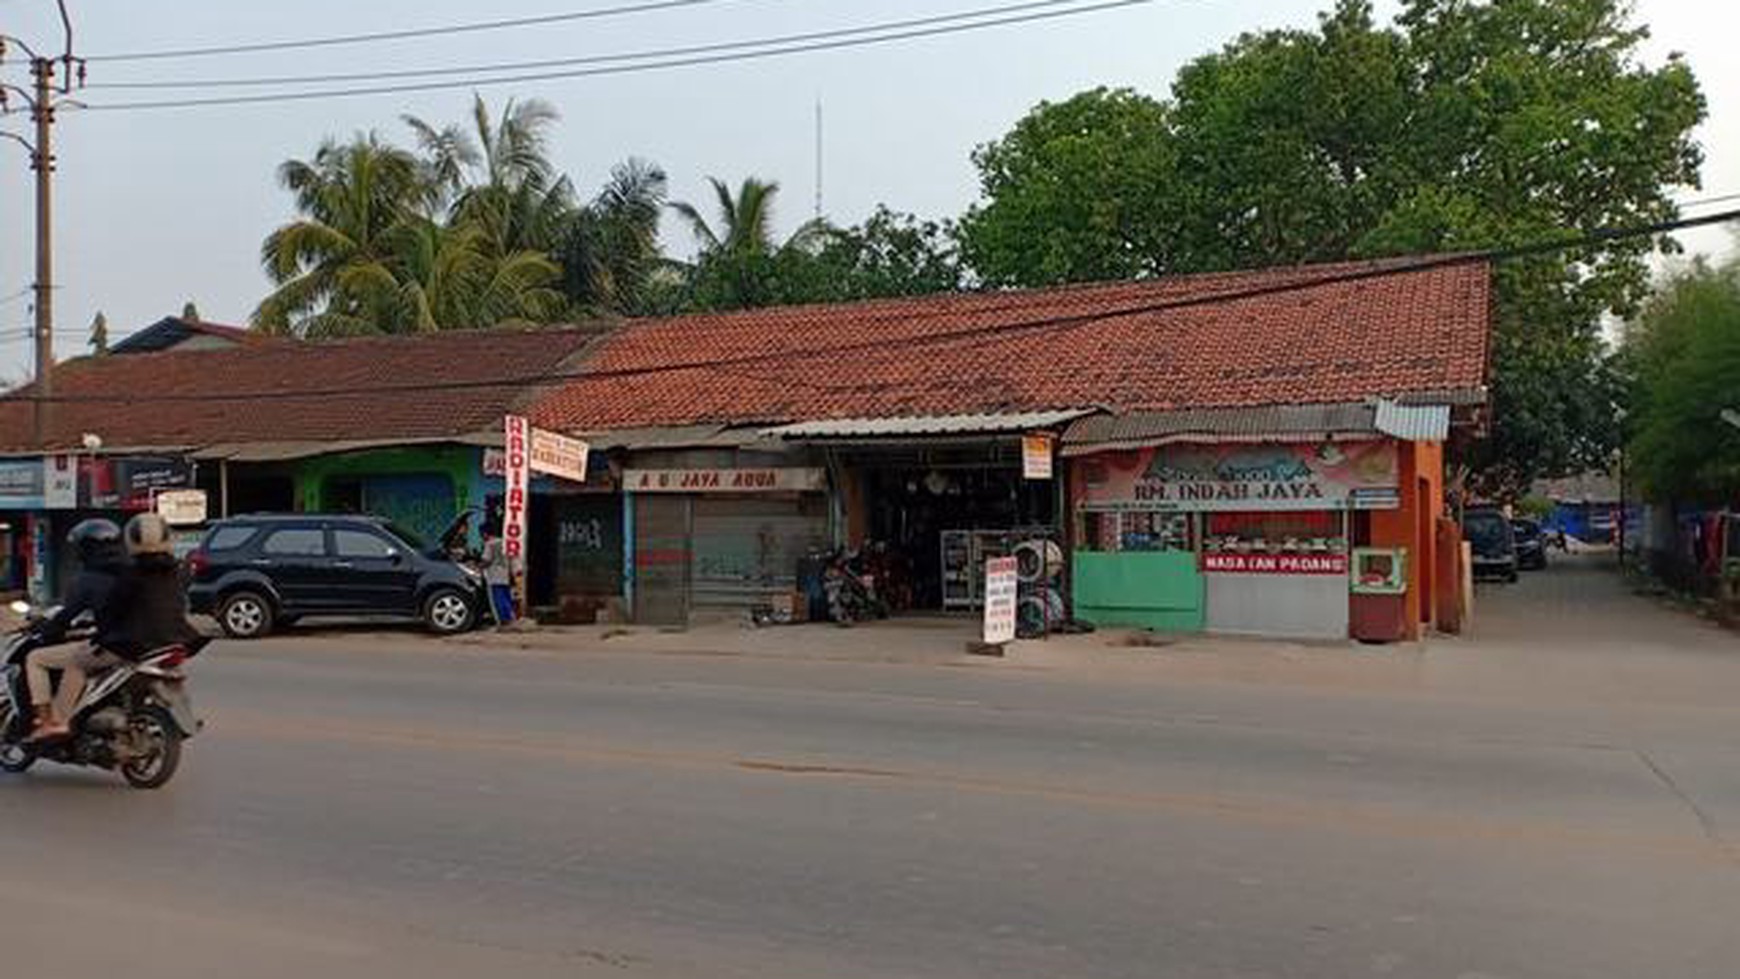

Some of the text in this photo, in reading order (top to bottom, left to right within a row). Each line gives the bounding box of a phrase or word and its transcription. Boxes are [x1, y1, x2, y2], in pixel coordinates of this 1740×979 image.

[506, 417, 523, 557] RADIATOR
[639, 473, 650, 488] A
[680, 472, 721, 488] JAYA
[1178, 484, 1250, 501] INDAH
[1258, 483, 1325, 499] JAYA
